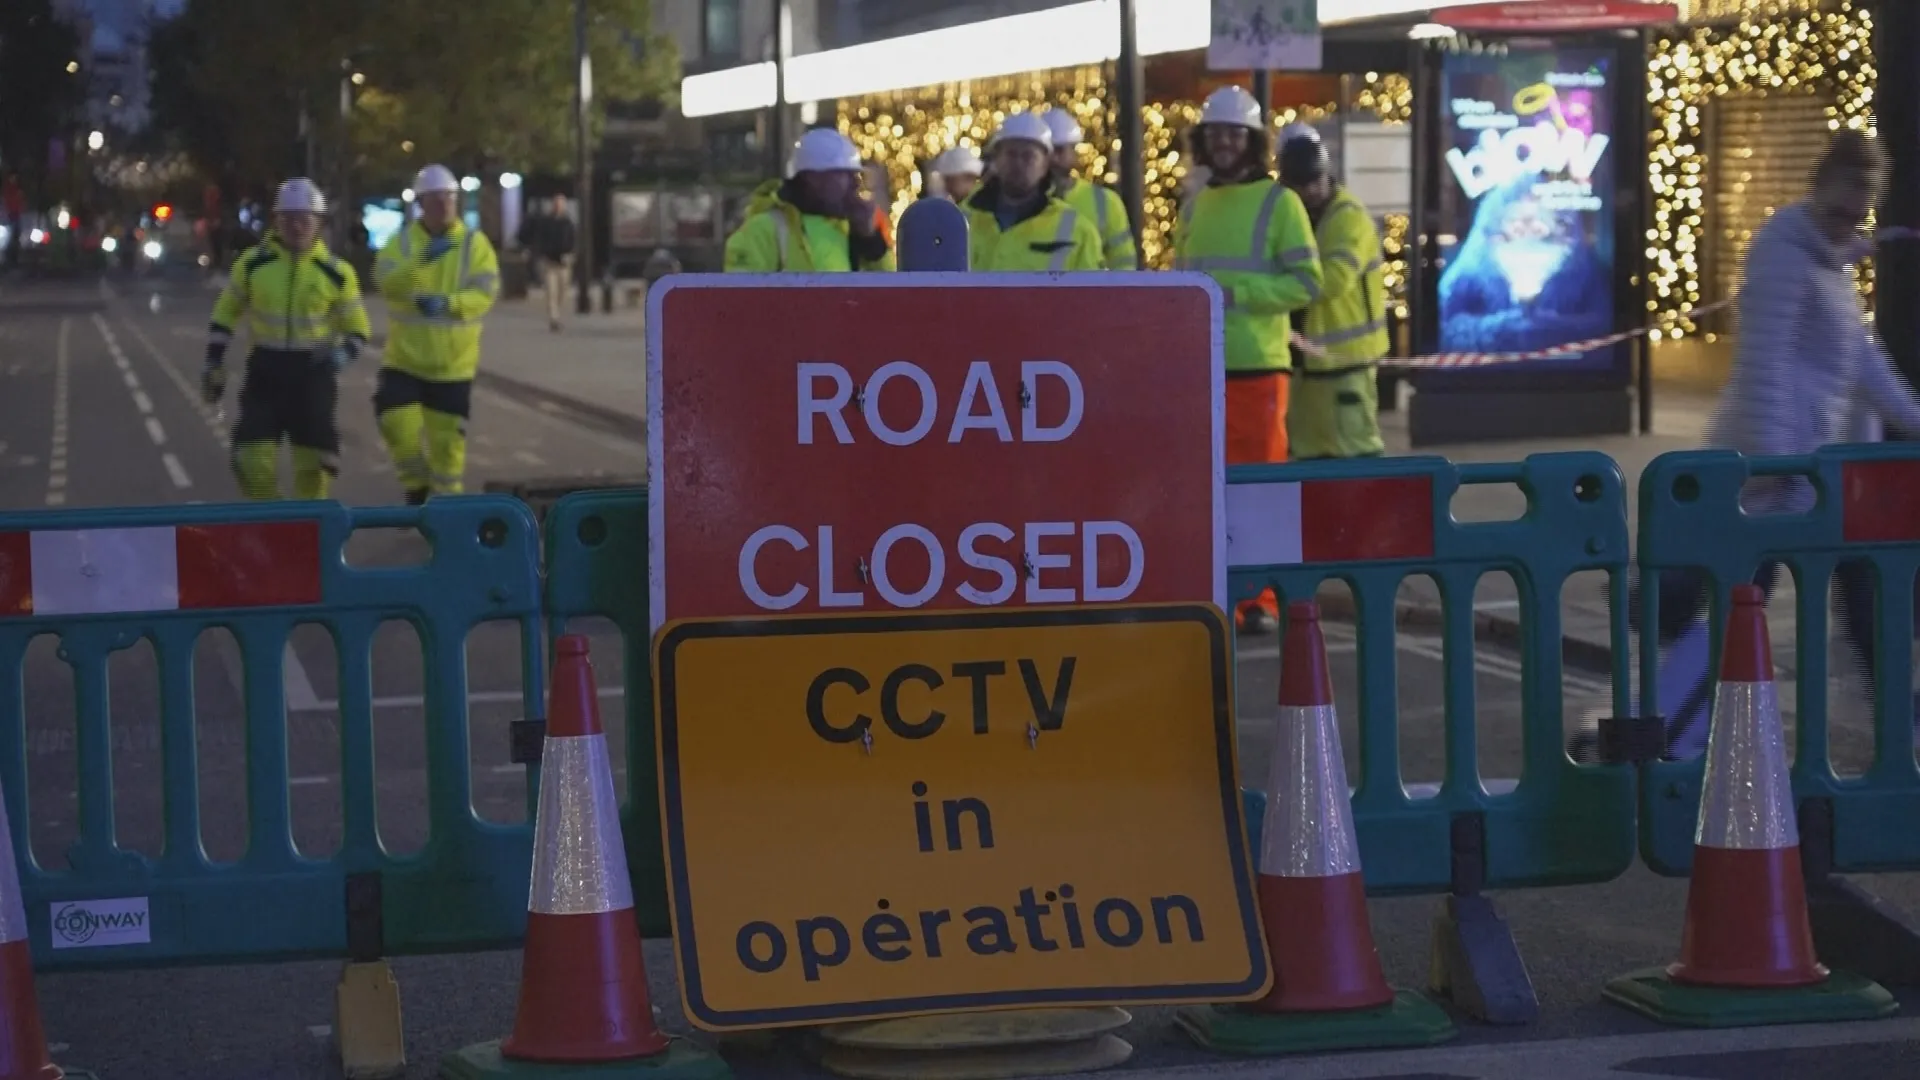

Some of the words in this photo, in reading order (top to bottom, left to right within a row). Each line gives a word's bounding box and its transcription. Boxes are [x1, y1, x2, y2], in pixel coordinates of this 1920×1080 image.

[797, 360, 1085, 446] ROAD
[738, 520, 1145, 610] CLOSED
[806, 656, 1077, 744] CCTV
[912, 780, 995, 853] in
[54, 909, 146, 932] CONWAY
[736, 883, 1205, 982] operation
